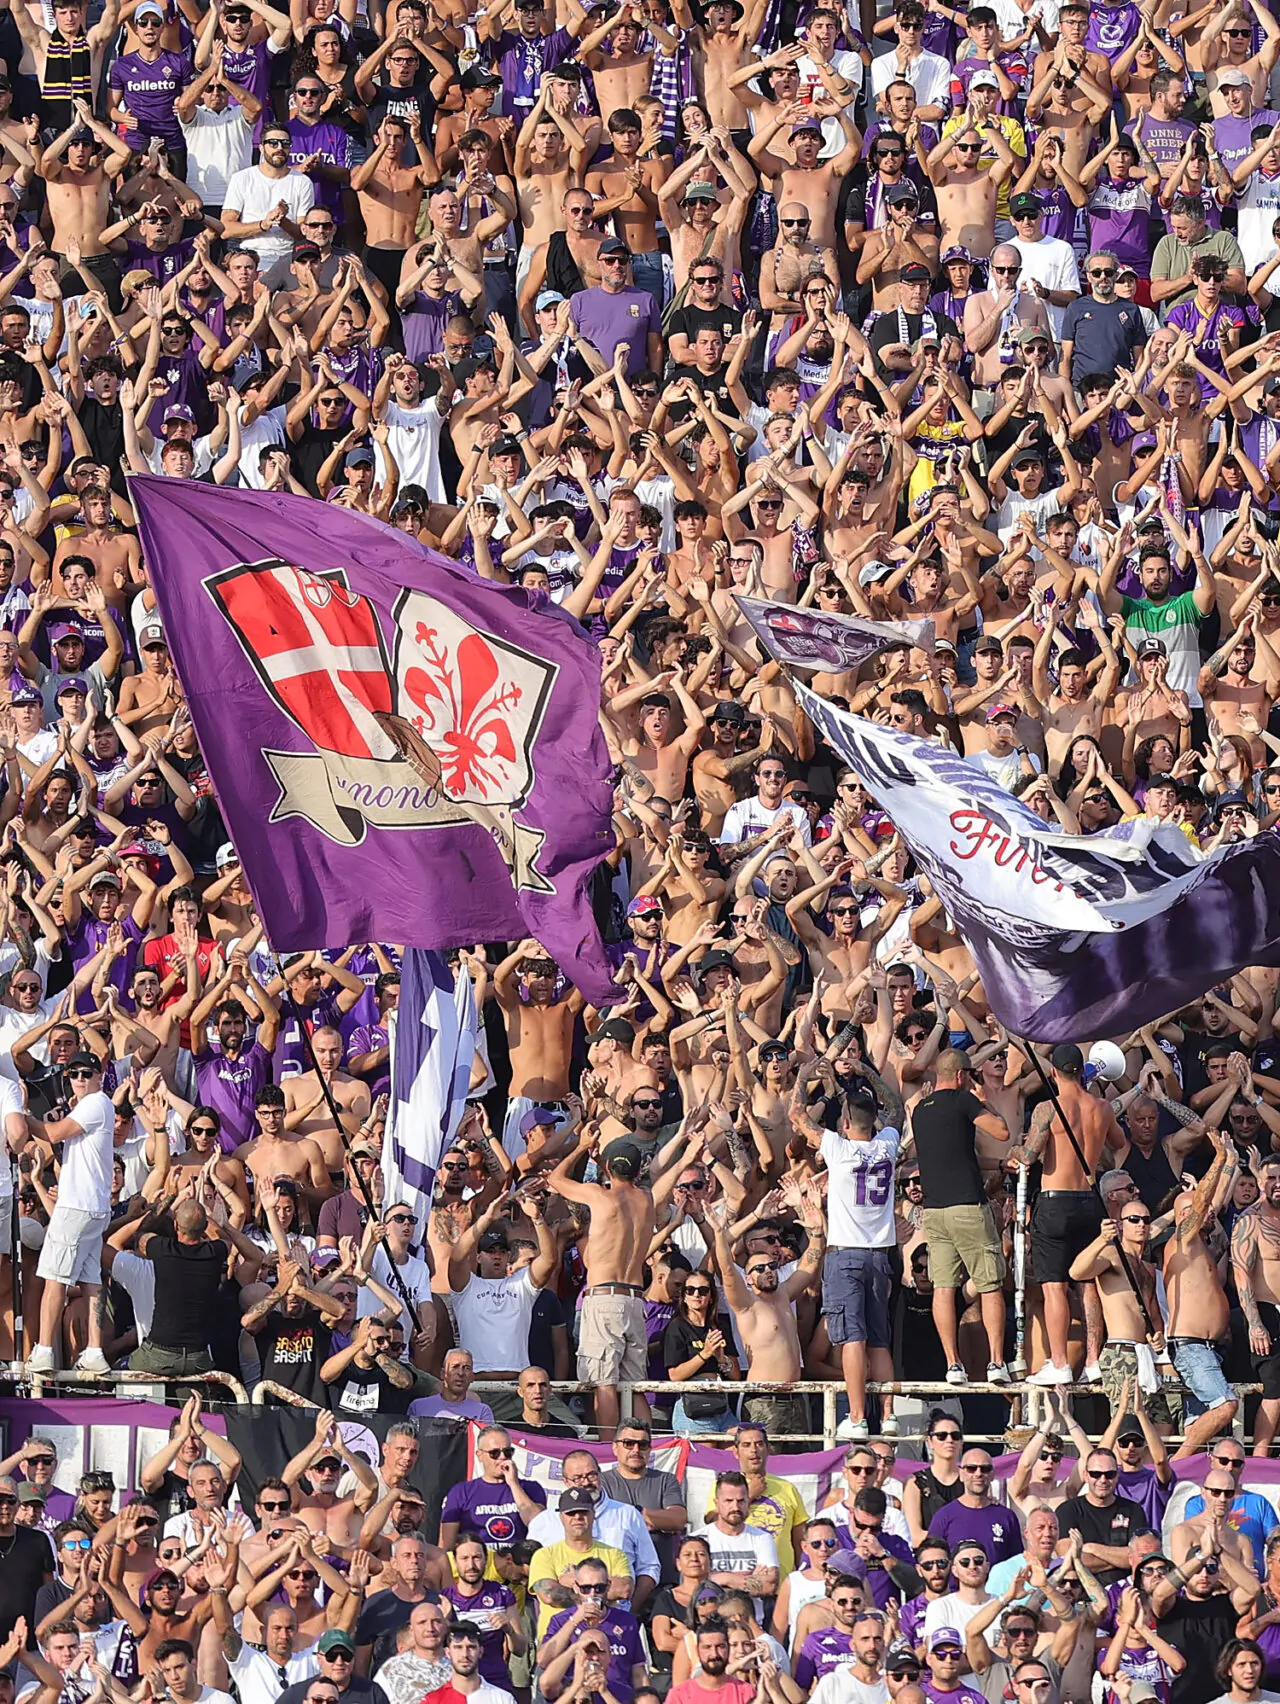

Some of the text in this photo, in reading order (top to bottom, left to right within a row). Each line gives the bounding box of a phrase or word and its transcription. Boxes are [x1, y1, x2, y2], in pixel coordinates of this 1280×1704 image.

[127, 79, 176, 92] folletto
[289, 153, 336, 165] TOYTA
[850, 1160, 894, 1208] 13
